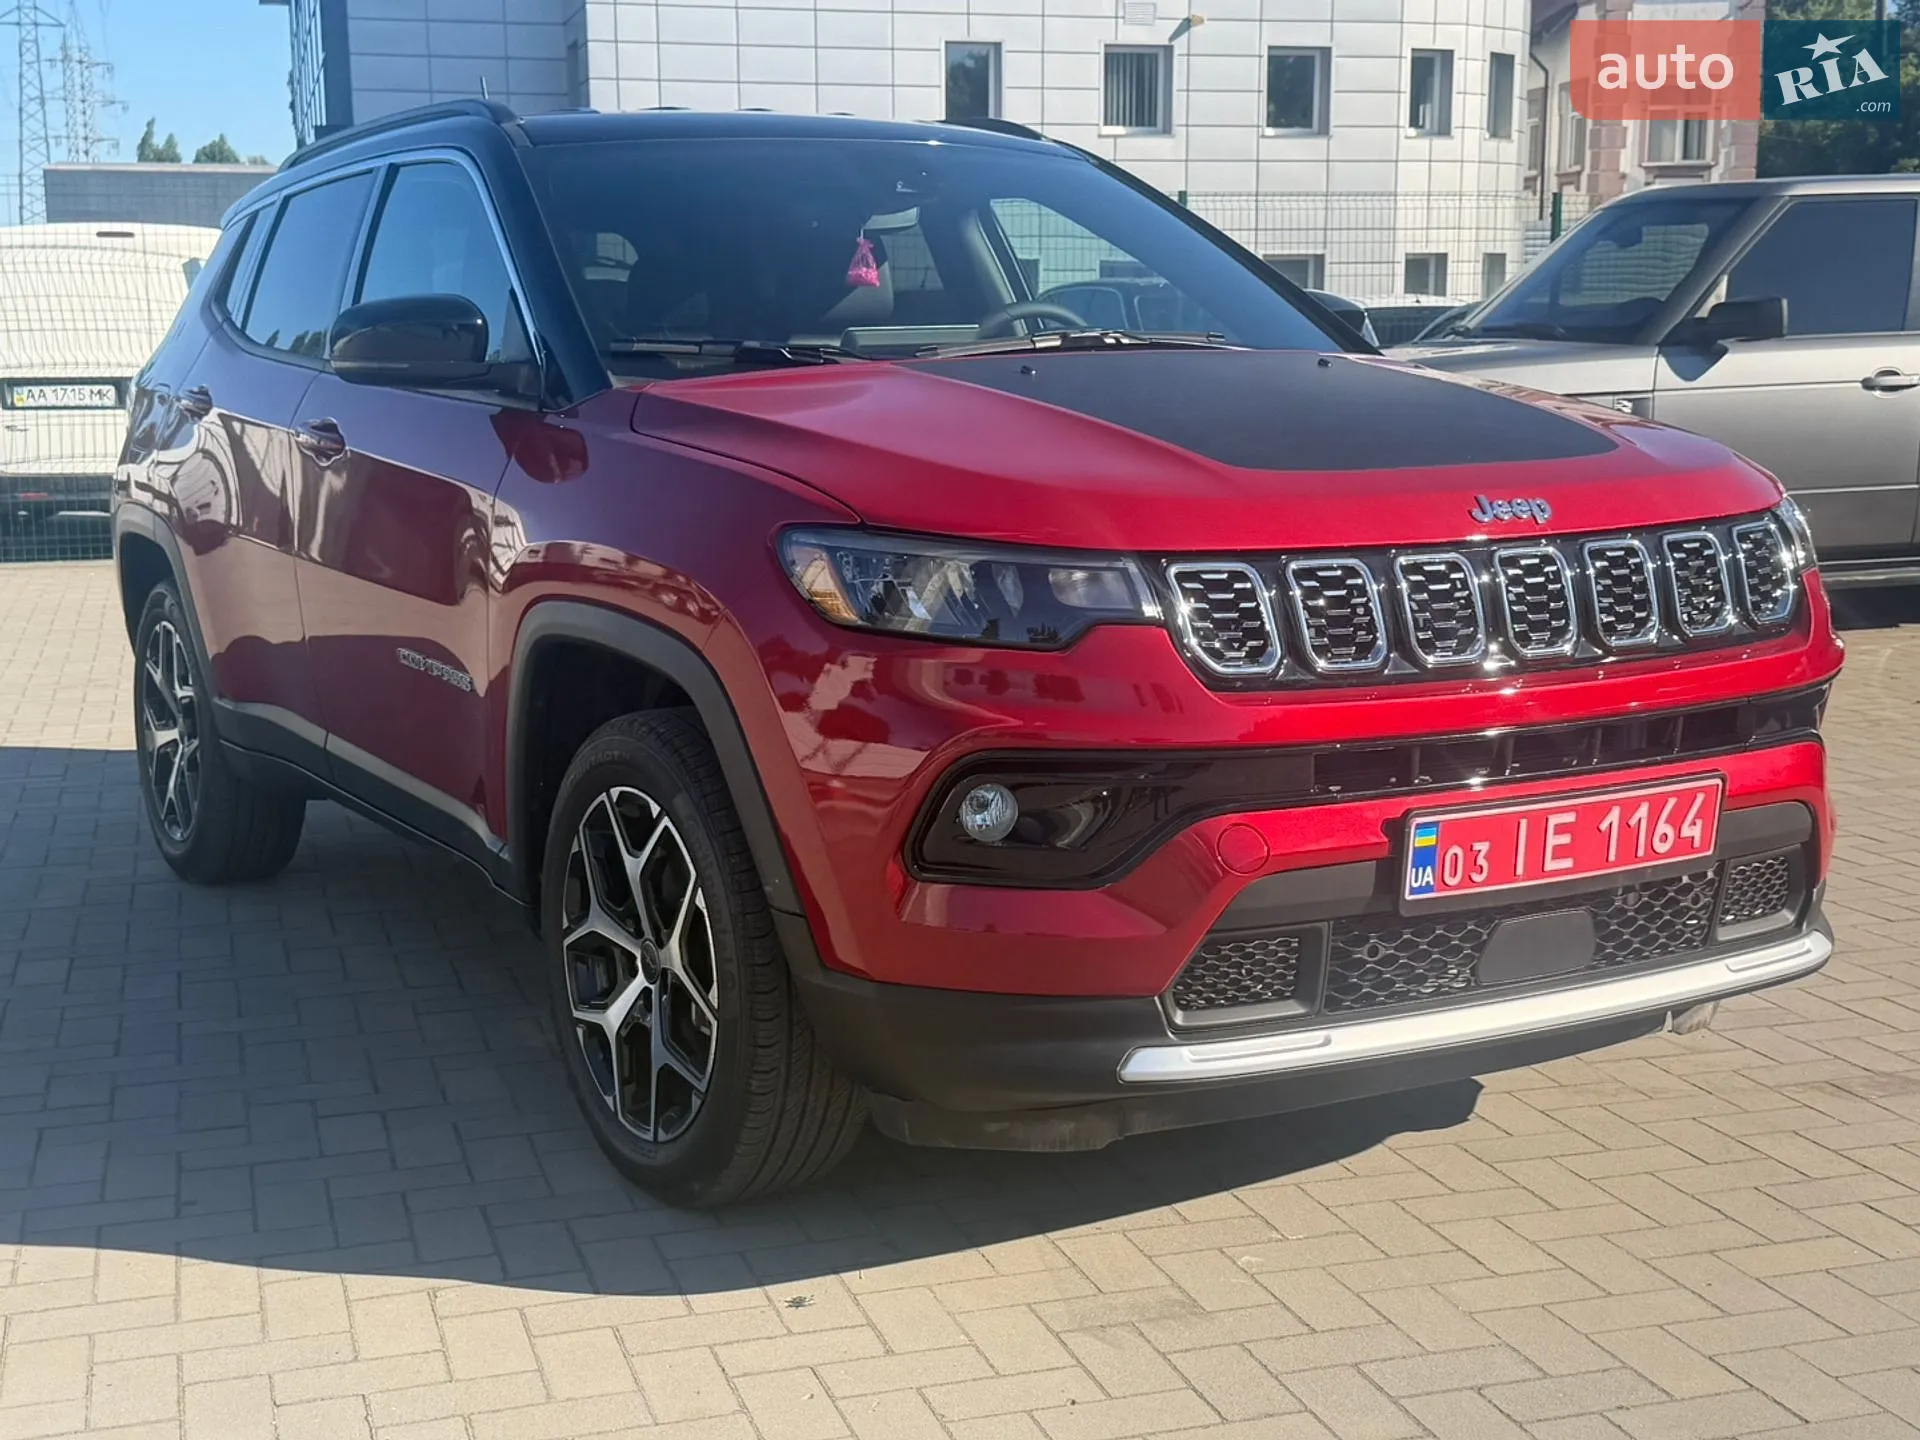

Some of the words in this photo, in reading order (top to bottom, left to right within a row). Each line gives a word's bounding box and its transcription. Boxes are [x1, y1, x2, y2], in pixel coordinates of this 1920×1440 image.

[26, 388, 48, 401] AA
[52, 388, 86, 401] 1715
[89, 388, 112, 401] MK
[1471, 494, 1552, 525] Jeep
[1442, 841, 1490, 886] 03
[1598, 792, 1705, 863] 1164
[1410, 866, 1434, 888] UA
